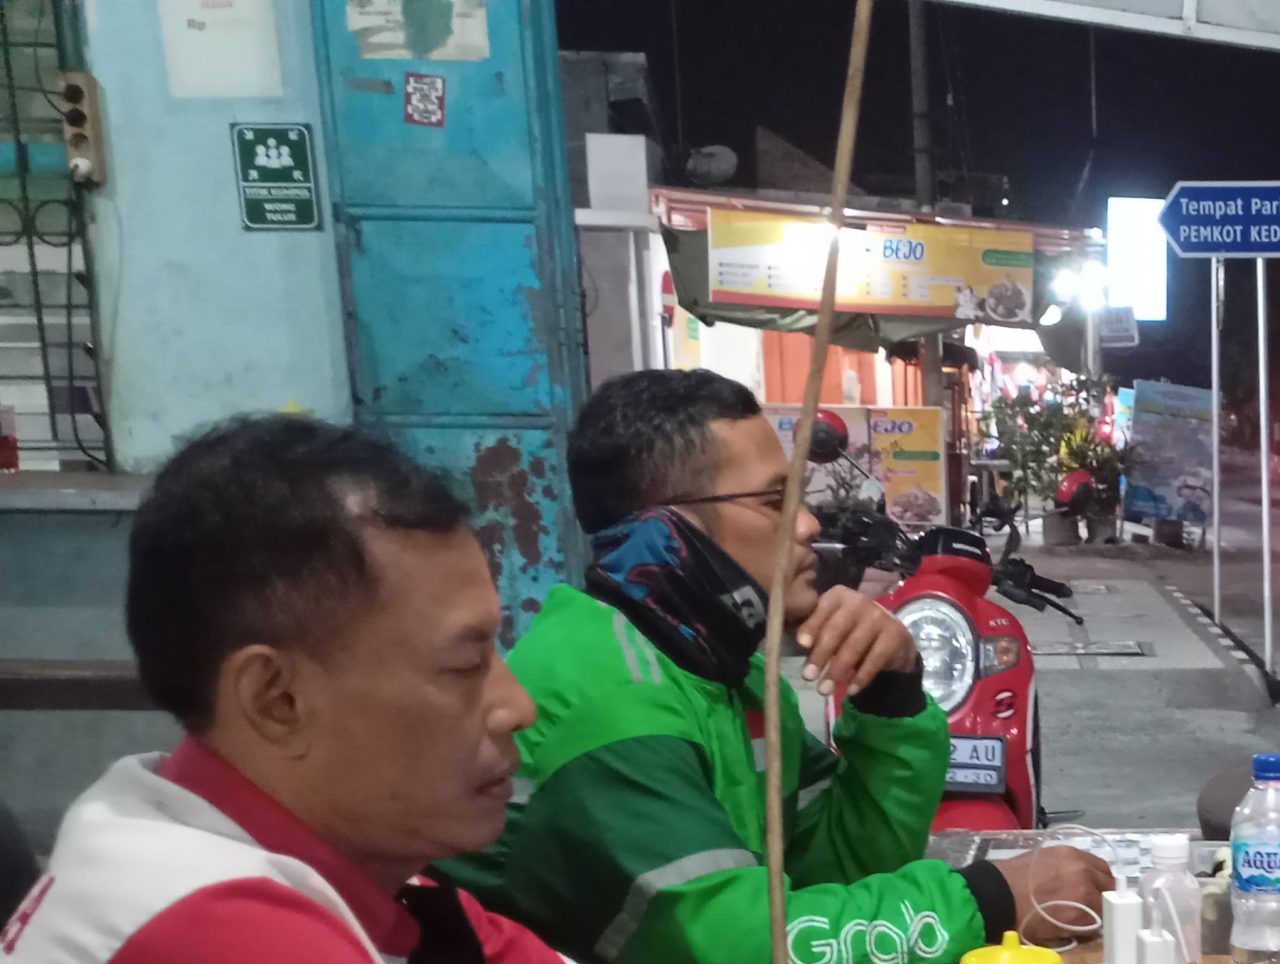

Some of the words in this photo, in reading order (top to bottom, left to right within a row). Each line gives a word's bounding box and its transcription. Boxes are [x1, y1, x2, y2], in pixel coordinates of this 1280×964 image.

[1179, 198, 1244, 220] Tempat
[1179, 225, 1244, 243] PEMKOT
[882, 239, 925, 262] BEJO
[872, 420, 913, 433] EJO
[968, 744, 996, 762] AU
